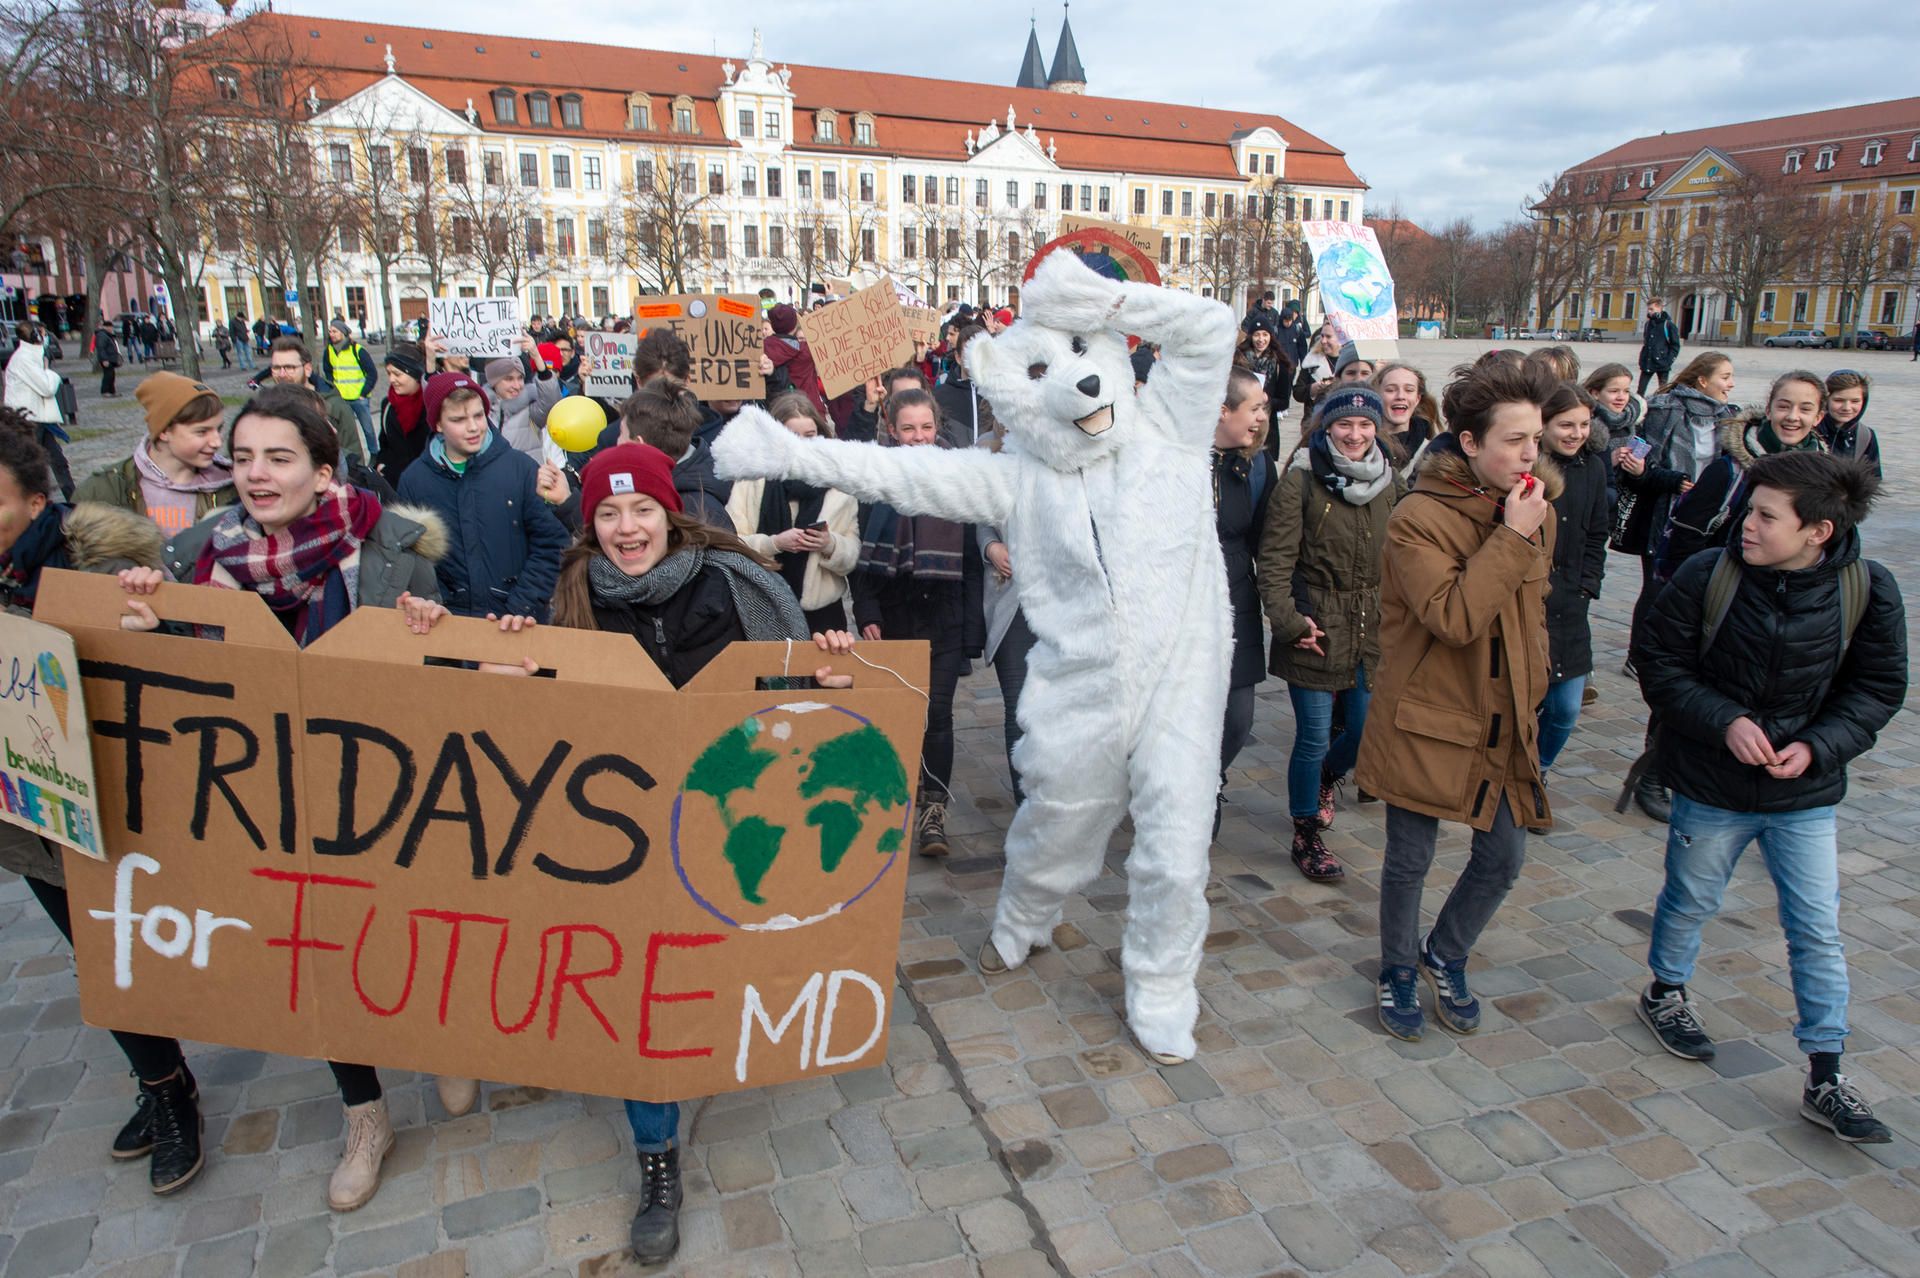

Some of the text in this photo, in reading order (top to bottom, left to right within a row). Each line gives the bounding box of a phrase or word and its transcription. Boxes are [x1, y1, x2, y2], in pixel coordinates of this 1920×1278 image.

[1347, 223, 1372, 242] THE
[432, 300, 517, 326] MAKE THE
[805, 282, 896, 343] STECKT KOHLE
[926, 310, 936, 322] IS
[432, 322, 519, 347] World great
[589, 334, 628, 357] Oma
[705, 318, 762, 357] UNSERE
[814, 343, 829, 362] IN
[832, 329, 854, 356] DIE
[856, 311, 903, 346] BILDUNG
[870, 344, 882, 359] IN
[884, 328, 906, 352] DEN
[591, 355, 608, 370] ist
[689, 357, 752, 389] ERDE
[4, 736, 89, 799] bewohnbaren
[79, 659, 657, 885] FRIDAYS
[88, 852, 886, 1083] for FUTURE MD
